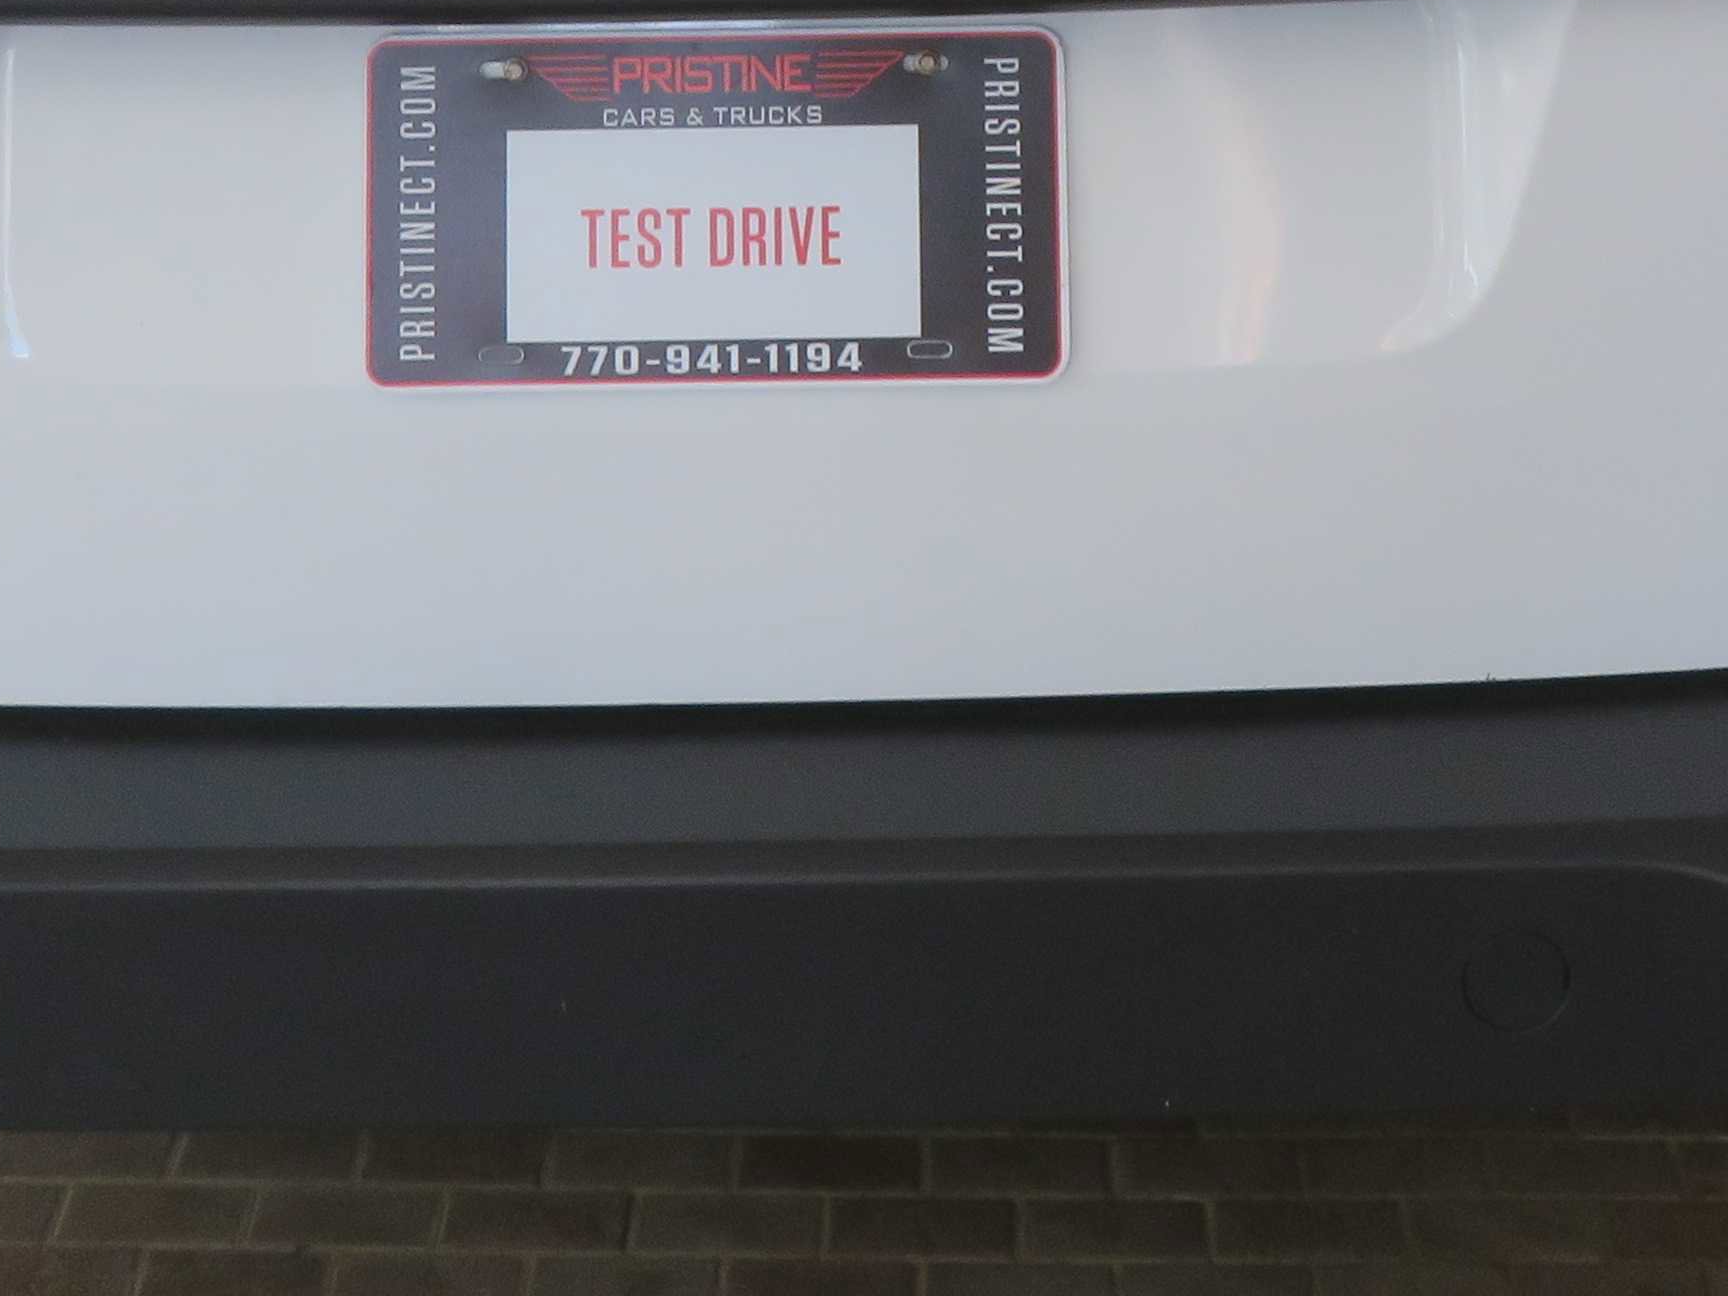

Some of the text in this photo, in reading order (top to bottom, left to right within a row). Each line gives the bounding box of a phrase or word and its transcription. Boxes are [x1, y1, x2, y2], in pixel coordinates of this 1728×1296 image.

[611, 52, 818, 95] PRISTINE
[601, 104, 824, 128] CARS & TRUCKS
[398, 64, 437, 362] PRISTINECT.COM
[982, 56, 1025, 355] PRISTINECT.COM
[580, 204, 843, 269] TEST DRIVE
[560, 340, 864, 377] 770-941-1194
